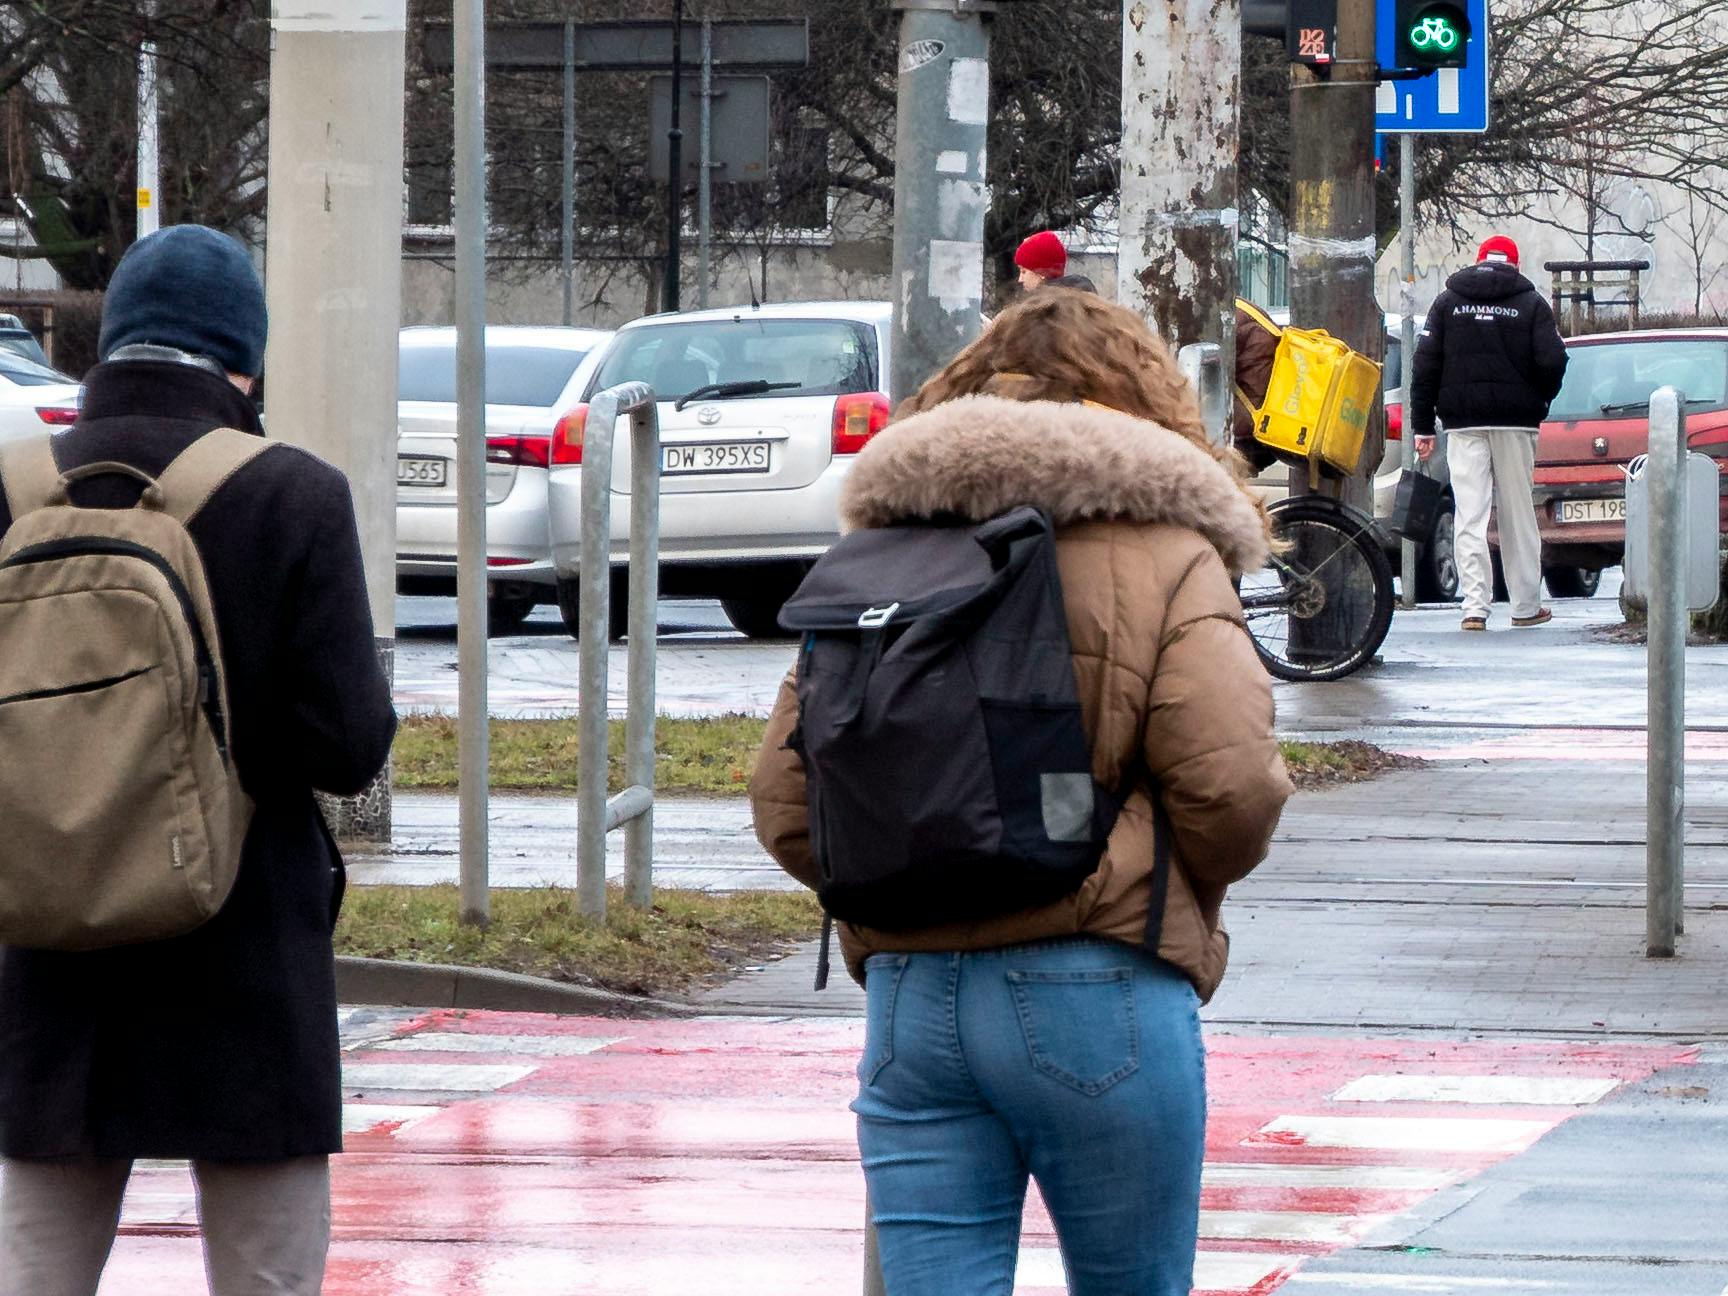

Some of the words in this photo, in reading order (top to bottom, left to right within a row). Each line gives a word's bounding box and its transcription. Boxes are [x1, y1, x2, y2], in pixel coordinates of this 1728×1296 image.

[667, 448, 696, 468] DW
[703, 445, 765, 467] 395XS
[1564, 502, 1593, 520] DST
